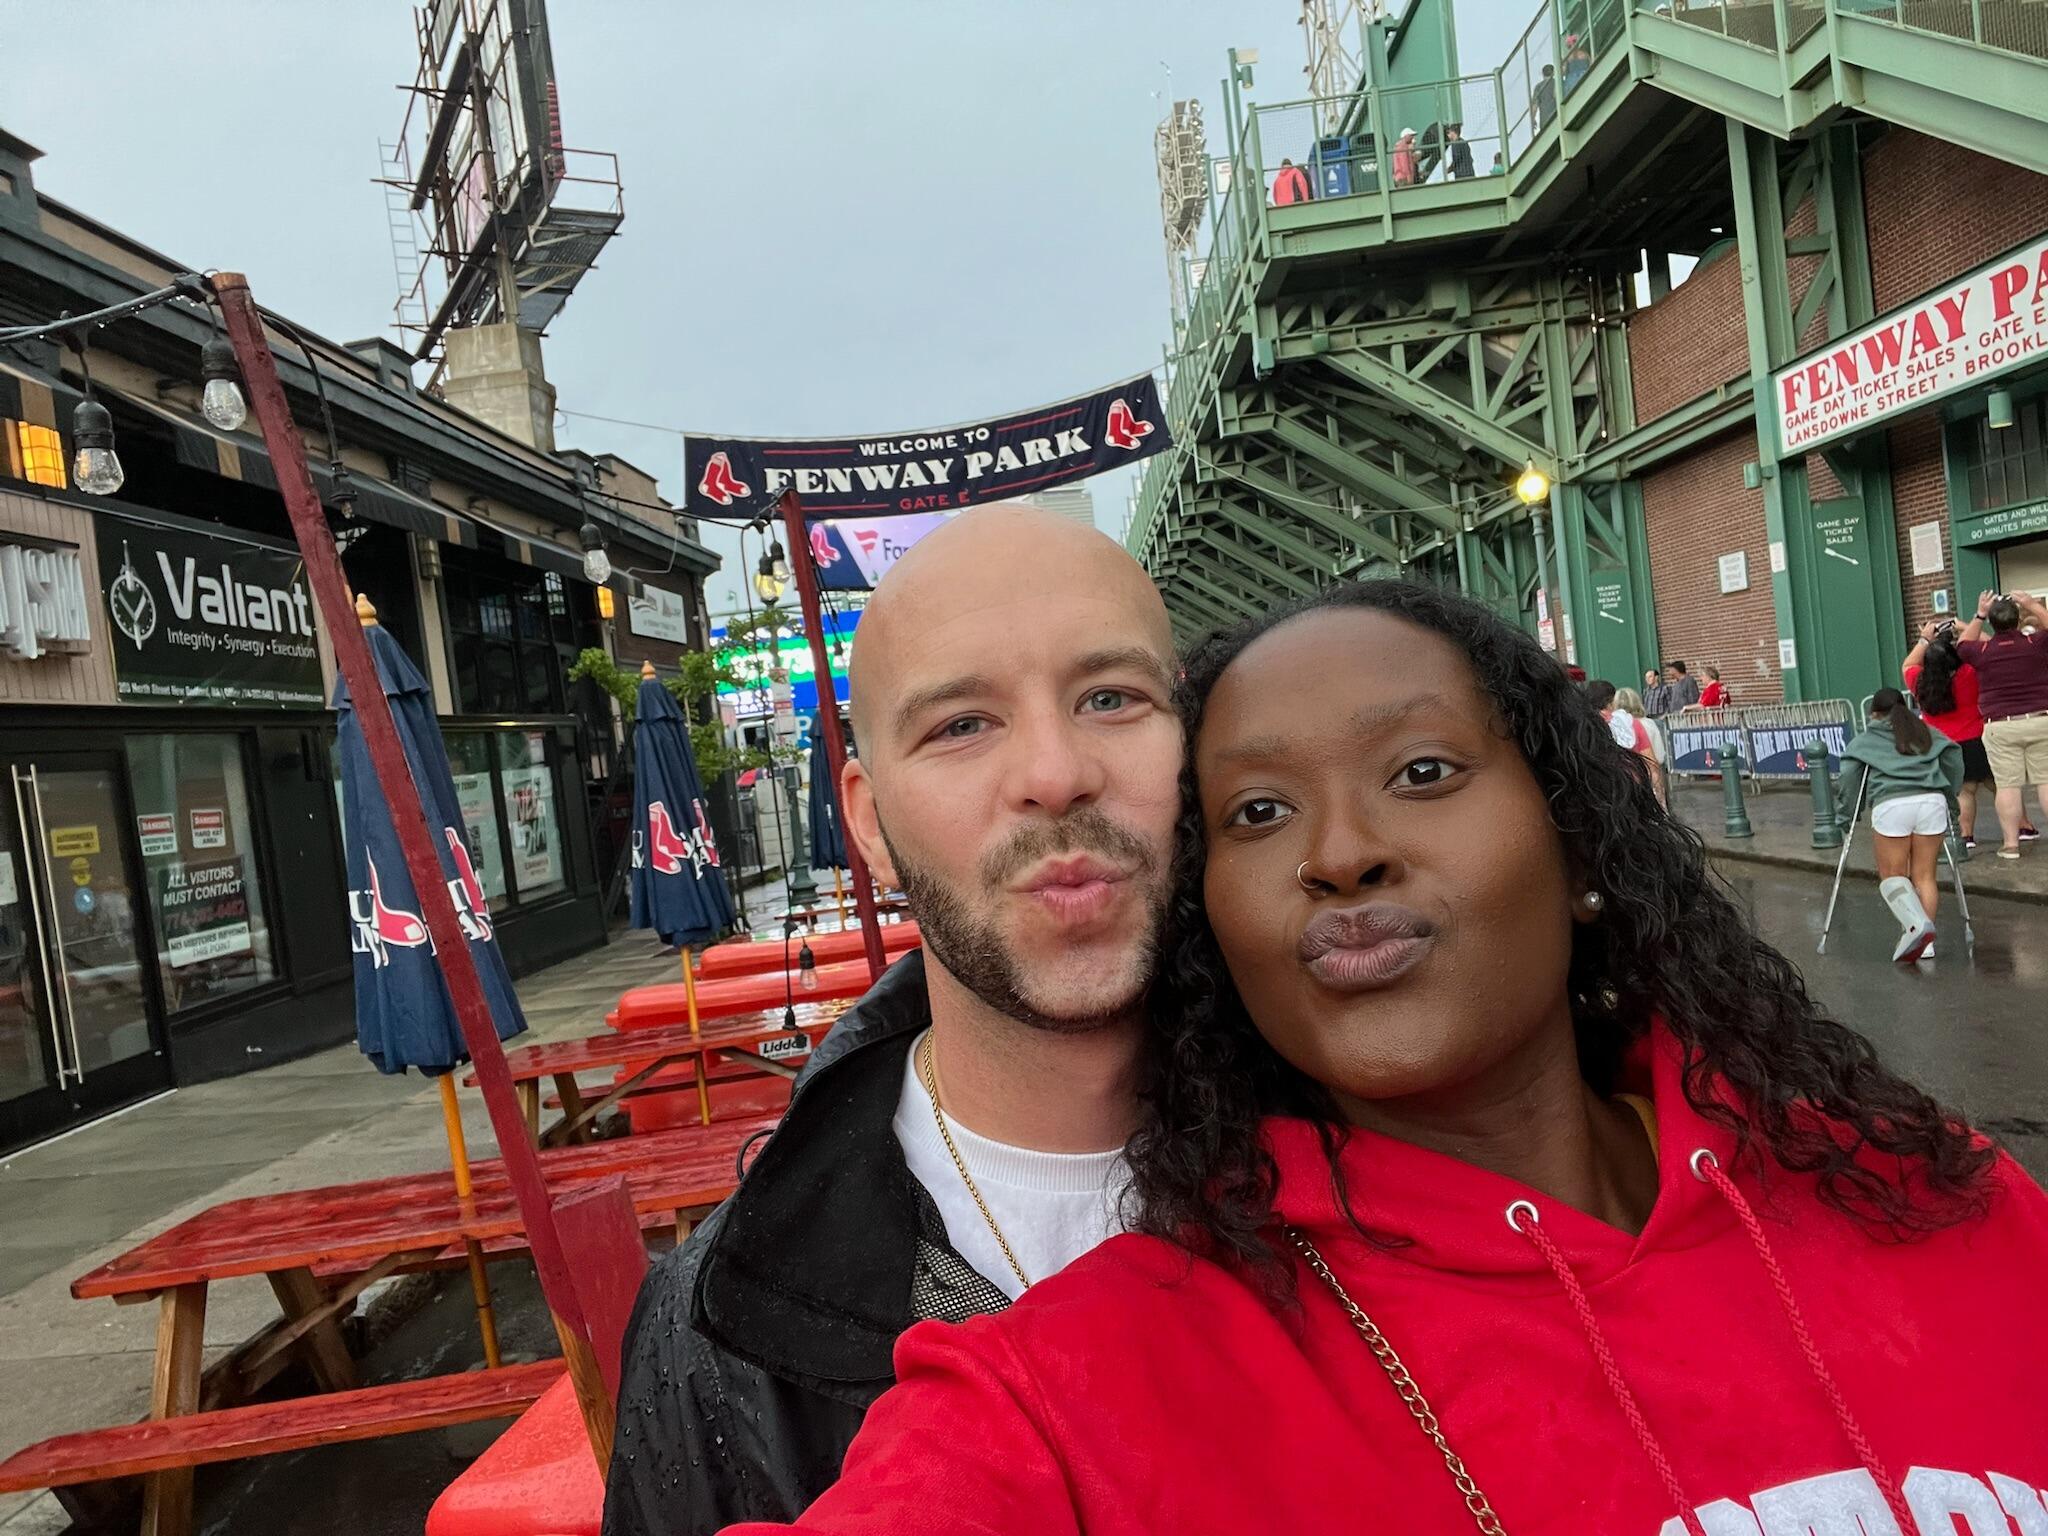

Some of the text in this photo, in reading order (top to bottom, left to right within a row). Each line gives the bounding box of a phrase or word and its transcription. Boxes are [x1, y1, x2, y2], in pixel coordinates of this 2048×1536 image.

[1781, 288, 1971, 415] FENWAY
[1785, 306, 2047, 430] GAME DAY TICKET SALES GATE E
[1787, 331, 2048, 447] LANSDOWNE STREET BROOKL
[859, 427, 990, 457] WELCOME TO
[764, 426, 1092, 494] FENWAY PARK
[900, 491, 970, 511] GATE E
[1816, 517, 1860, 529] GAME DAY
[1971, 516, 2047, 539] 90 MINUTES PRIOR
[1983, 512, 2008, 525] GATES
[2011, 509, 2027, 519] AND
[1824, 526, 1854, 536] TICKET
[1826, 535, 1854, 545] SALES
[155, 551, 313, 637] Valiant
[167, 627, 317, 659] Integrity Synergy Execution
[1790, 729, 1818, 750] TICKET
[167, 866, 235, 889] ALL VISITORS
[163, 880, 242, 907] MUST CONTACT
